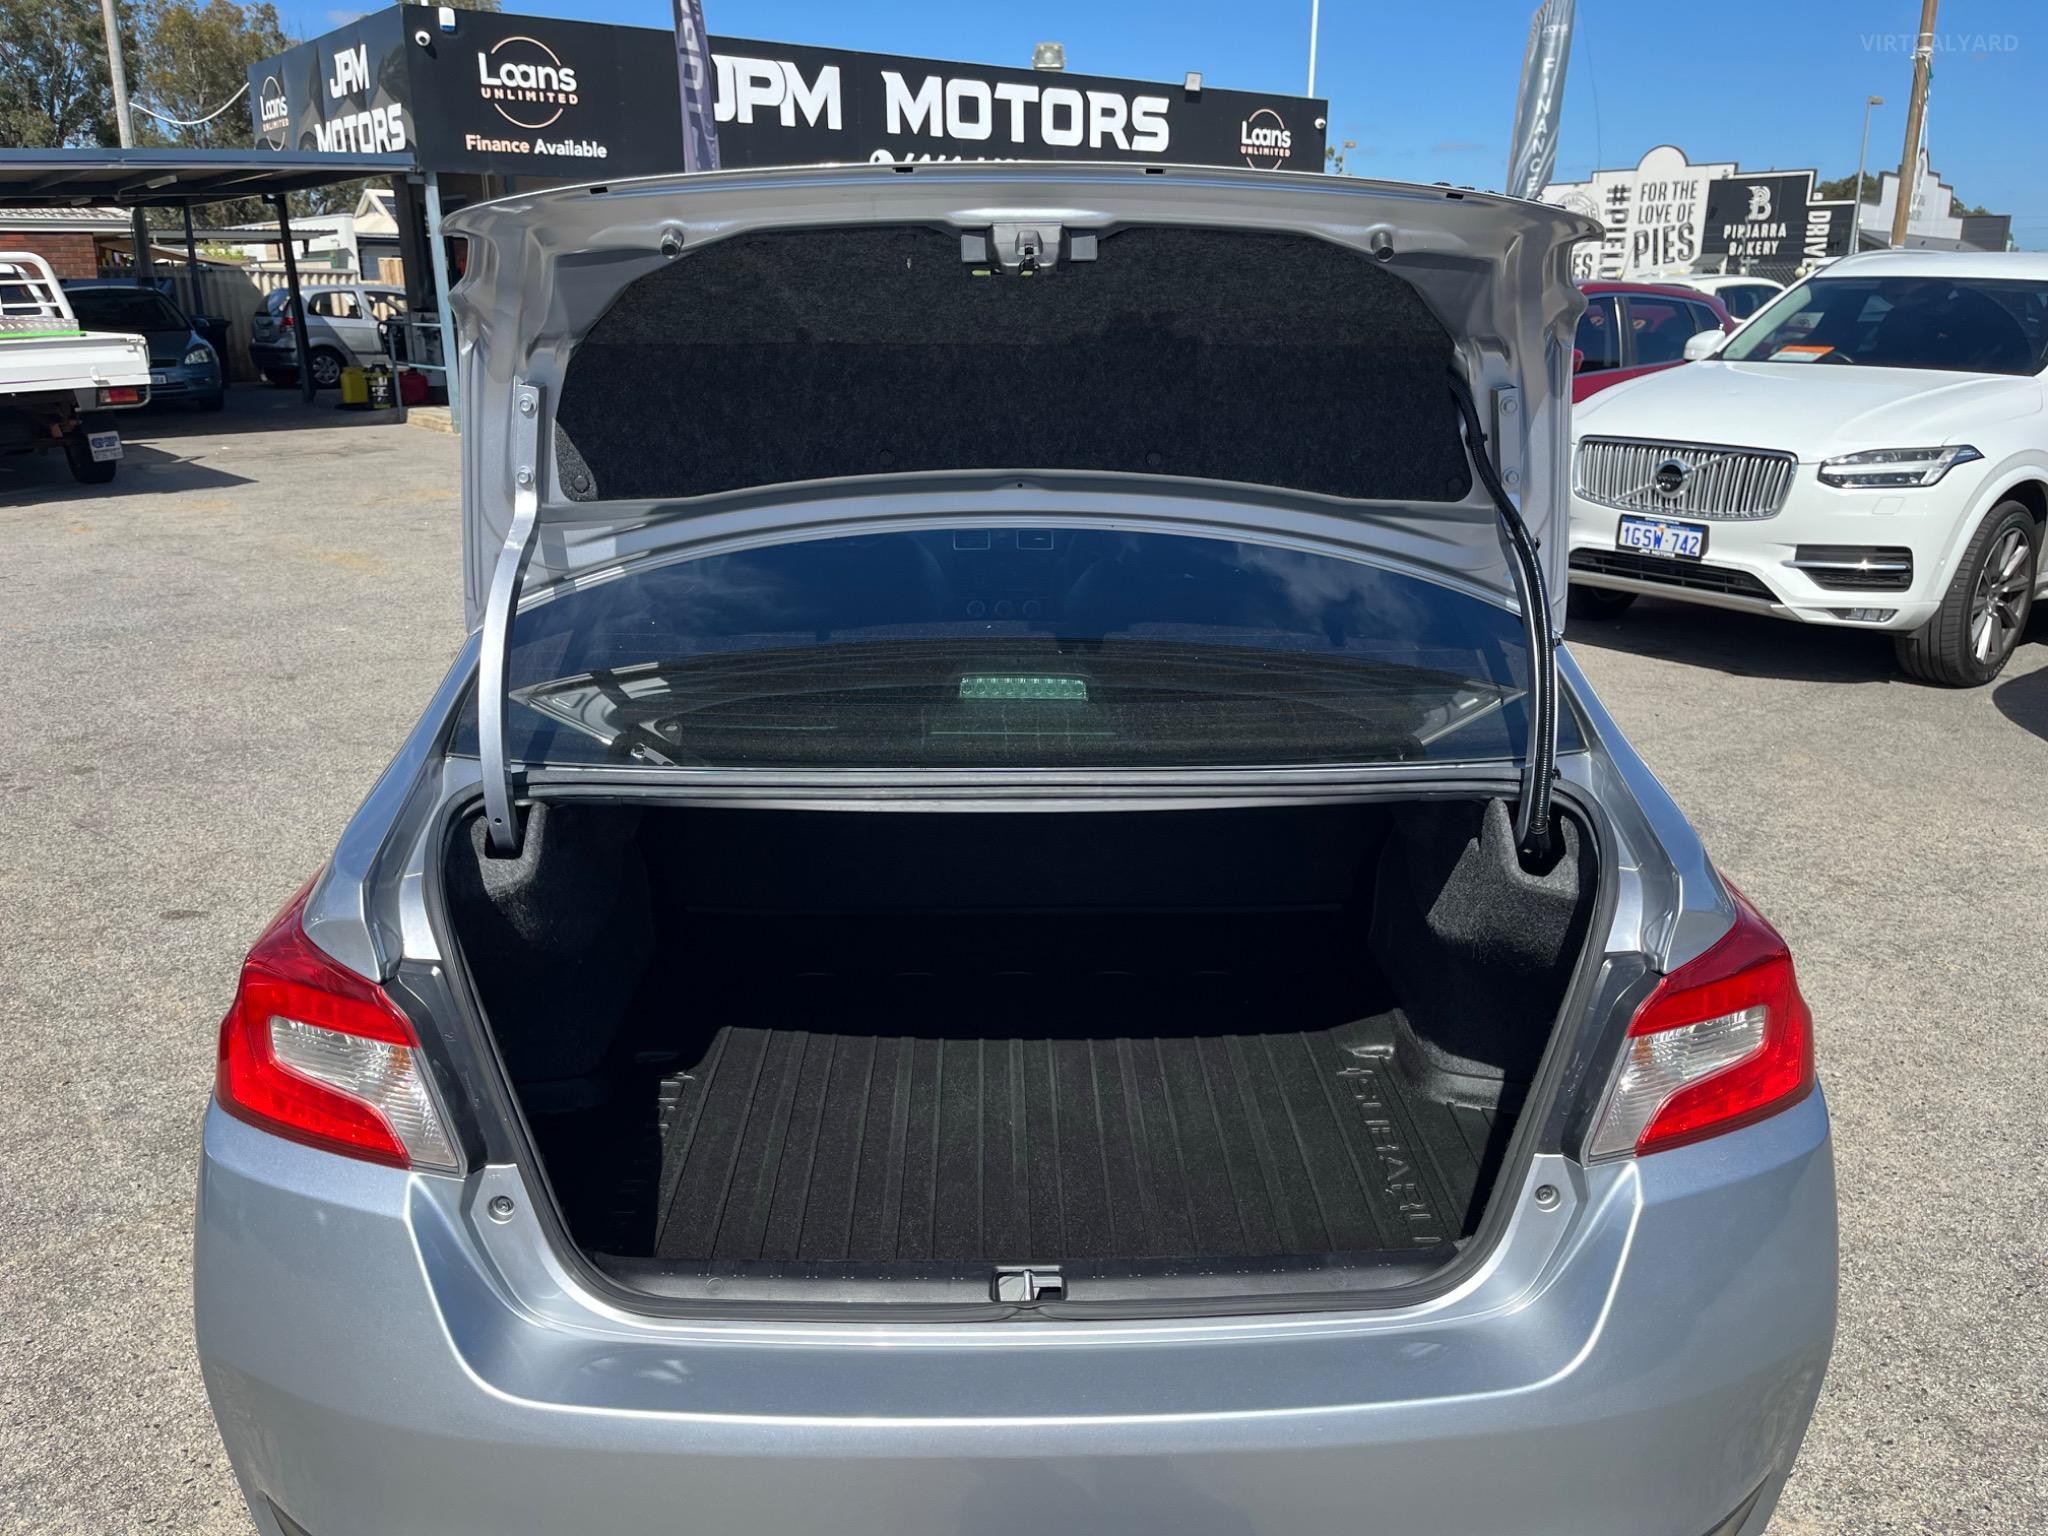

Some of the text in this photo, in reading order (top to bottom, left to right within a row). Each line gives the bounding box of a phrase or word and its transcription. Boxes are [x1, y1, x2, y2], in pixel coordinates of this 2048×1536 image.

[329, 44, 370, 100] JPM
[477, 52, 578, 92] Loans
[711, 53, 842, 130] JPM
[480, 87, 579, 105] UNLIMITED
[880, 70, 1170, 153] MOTORS
[314, 103, 406, 153] MOTORS
[1241, 120, 1292, 148] Loans
[1526, 57, 1555, 194] FINANCE
[465, 134, 607, 159] Finance Available
[1240, 145, 1291, 157] UNLIMITED
[1640, 179, 1699, 203] FOR THE
[1638, 203, 1696, 225] LOVE OF
[1633, 222, 1694, 269] PIES
